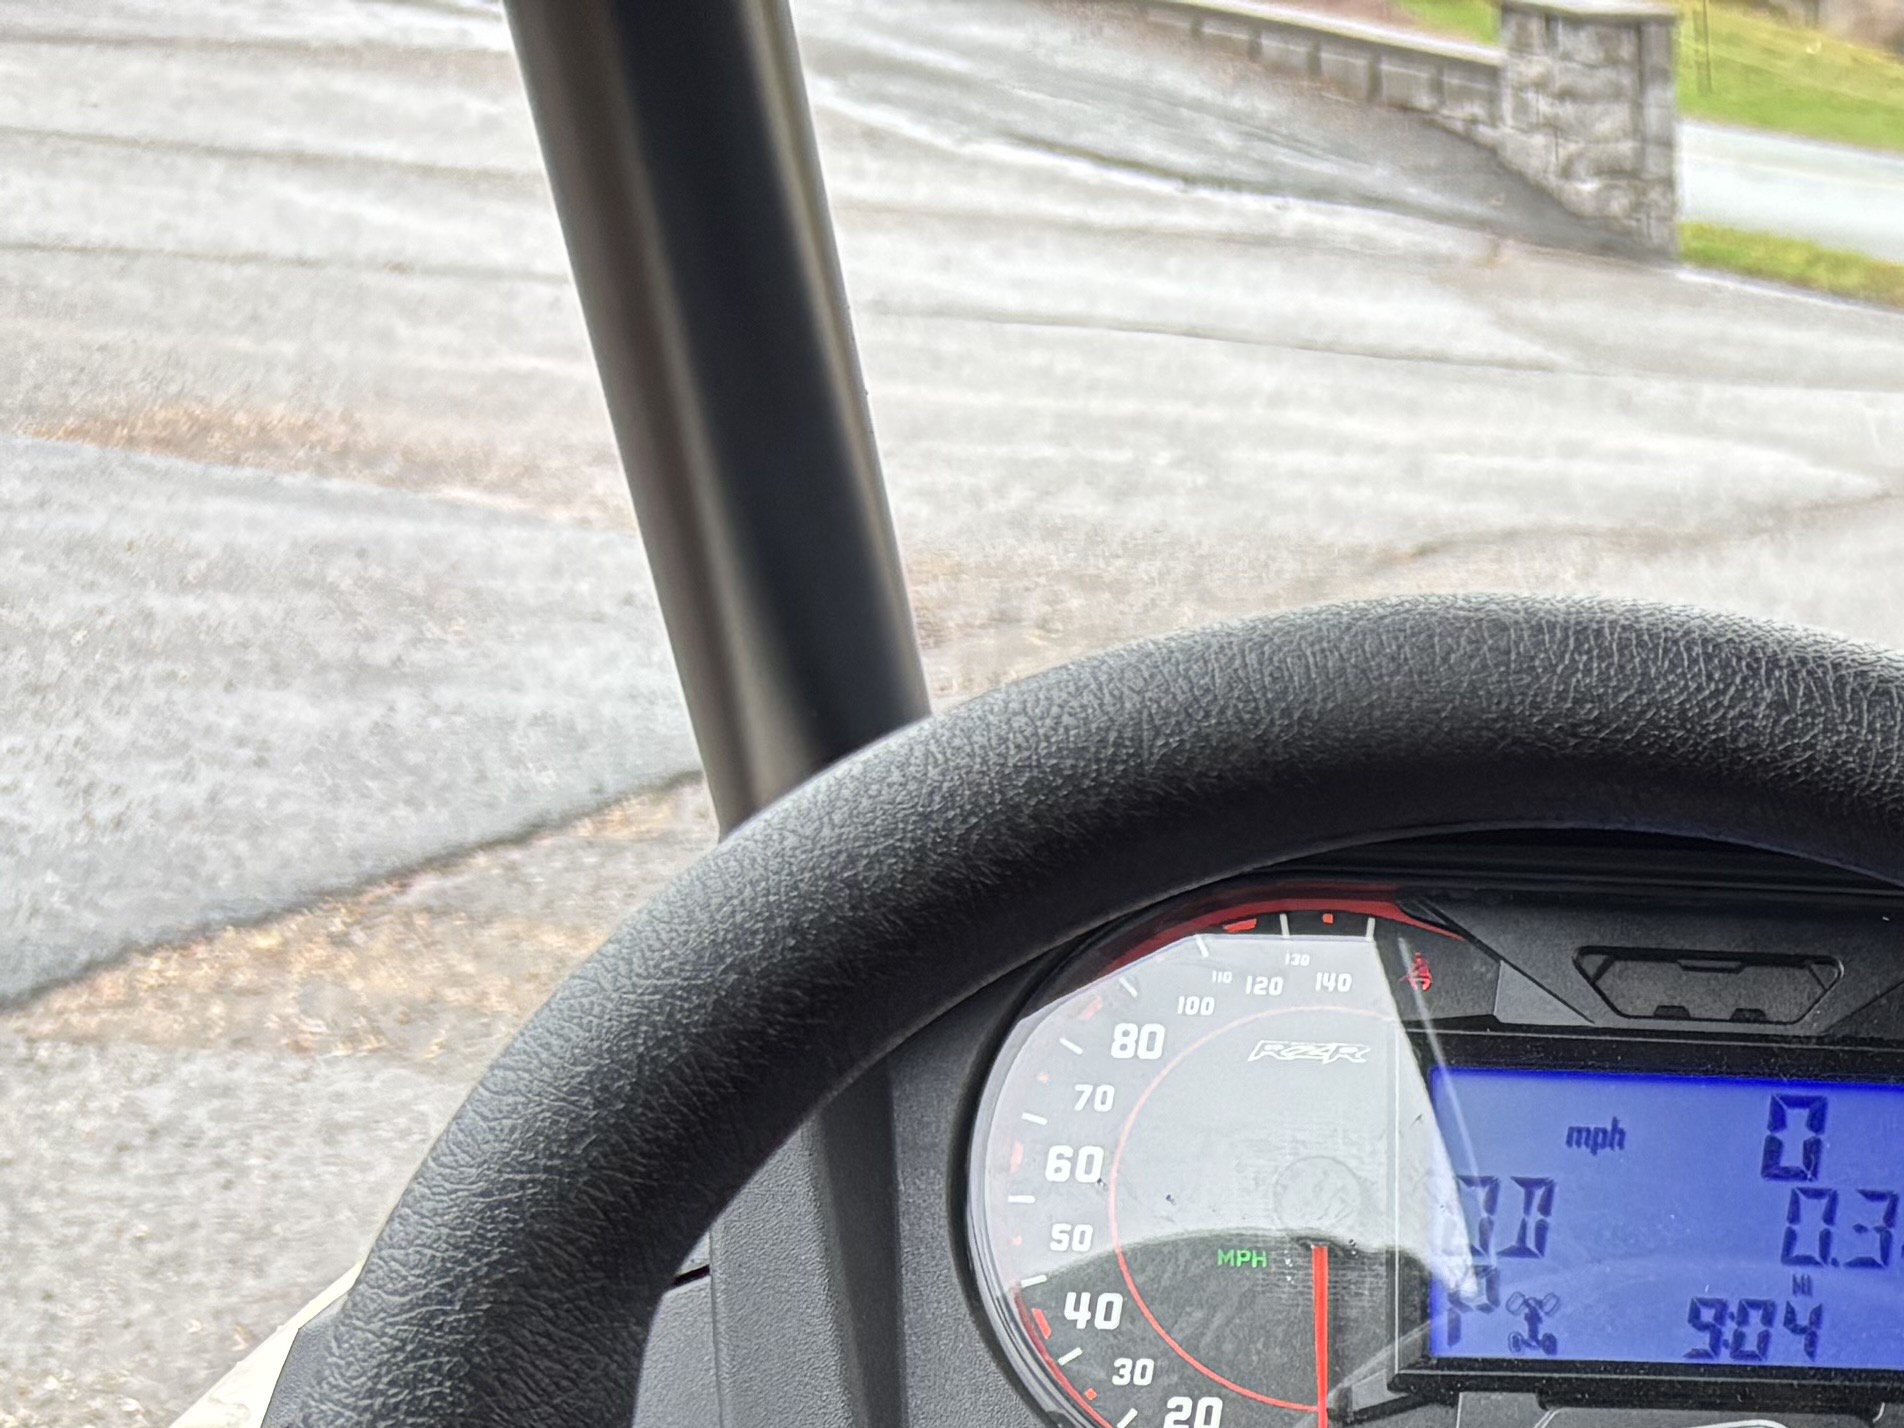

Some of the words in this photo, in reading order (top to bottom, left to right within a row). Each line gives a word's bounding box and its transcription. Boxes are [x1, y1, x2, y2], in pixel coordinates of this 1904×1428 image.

[1285, 951, 1310, 966] 130
[1212, 970, 1232, 984] 110
[1245, 975, 1284, 996] 120
[1315, 972, 1352, 993] 140
[1177, 996, 1216, 1016] 100
[1110, 1024, 1166, 1060] 80
[1074, 1084, 1116, 1112] 70
[1566, 1117, 1626, 1156] mph
[1761, 1094, 1828, 1182] 0
[1045, 1145, 1104, 1184] 60
[1050, 1224, 1094, 1252] 50
[1781, 1187, 1900, 1269] 0.3
[1217, 1248, 1267, 1269] MPH
[1063, 1293, 1123, 1330] 40
[1684, 1297, 1823, 1361] 9:04
[1112, 1358, 1155, 1386] 30
